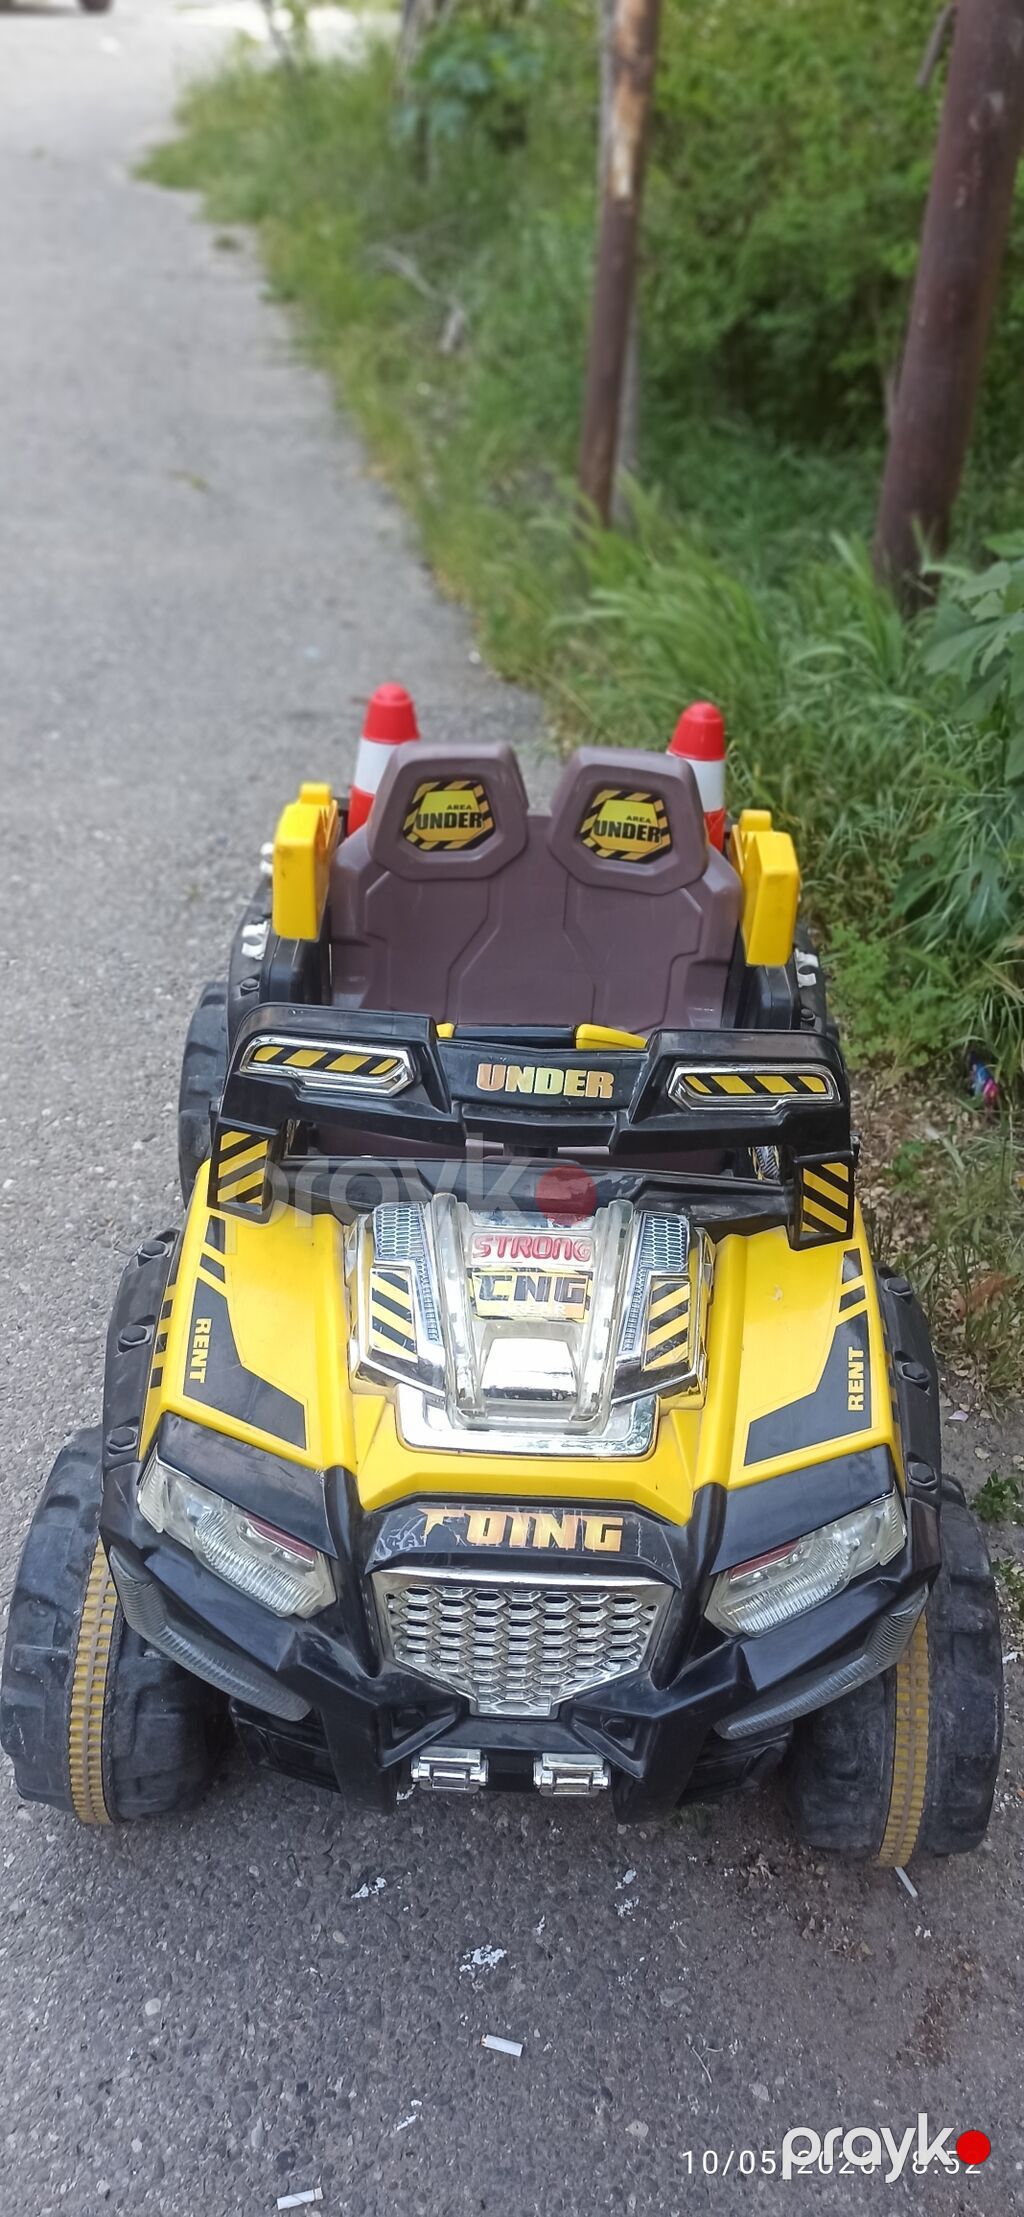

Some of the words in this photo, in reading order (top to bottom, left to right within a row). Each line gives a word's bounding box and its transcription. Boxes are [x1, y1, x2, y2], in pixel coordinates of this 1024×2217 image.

[416, 811, 483, 830] UNDER
[595, 820, 661, 843] UNDER
[626, 815, 652, 823] AREA
[476, 1063, 615, 1099] UNDER
[472, 1234, 592, 1263] STRONG
[189, 1318, 212, 1384] RENT
[848, 1347, 865, 1411] RENT
